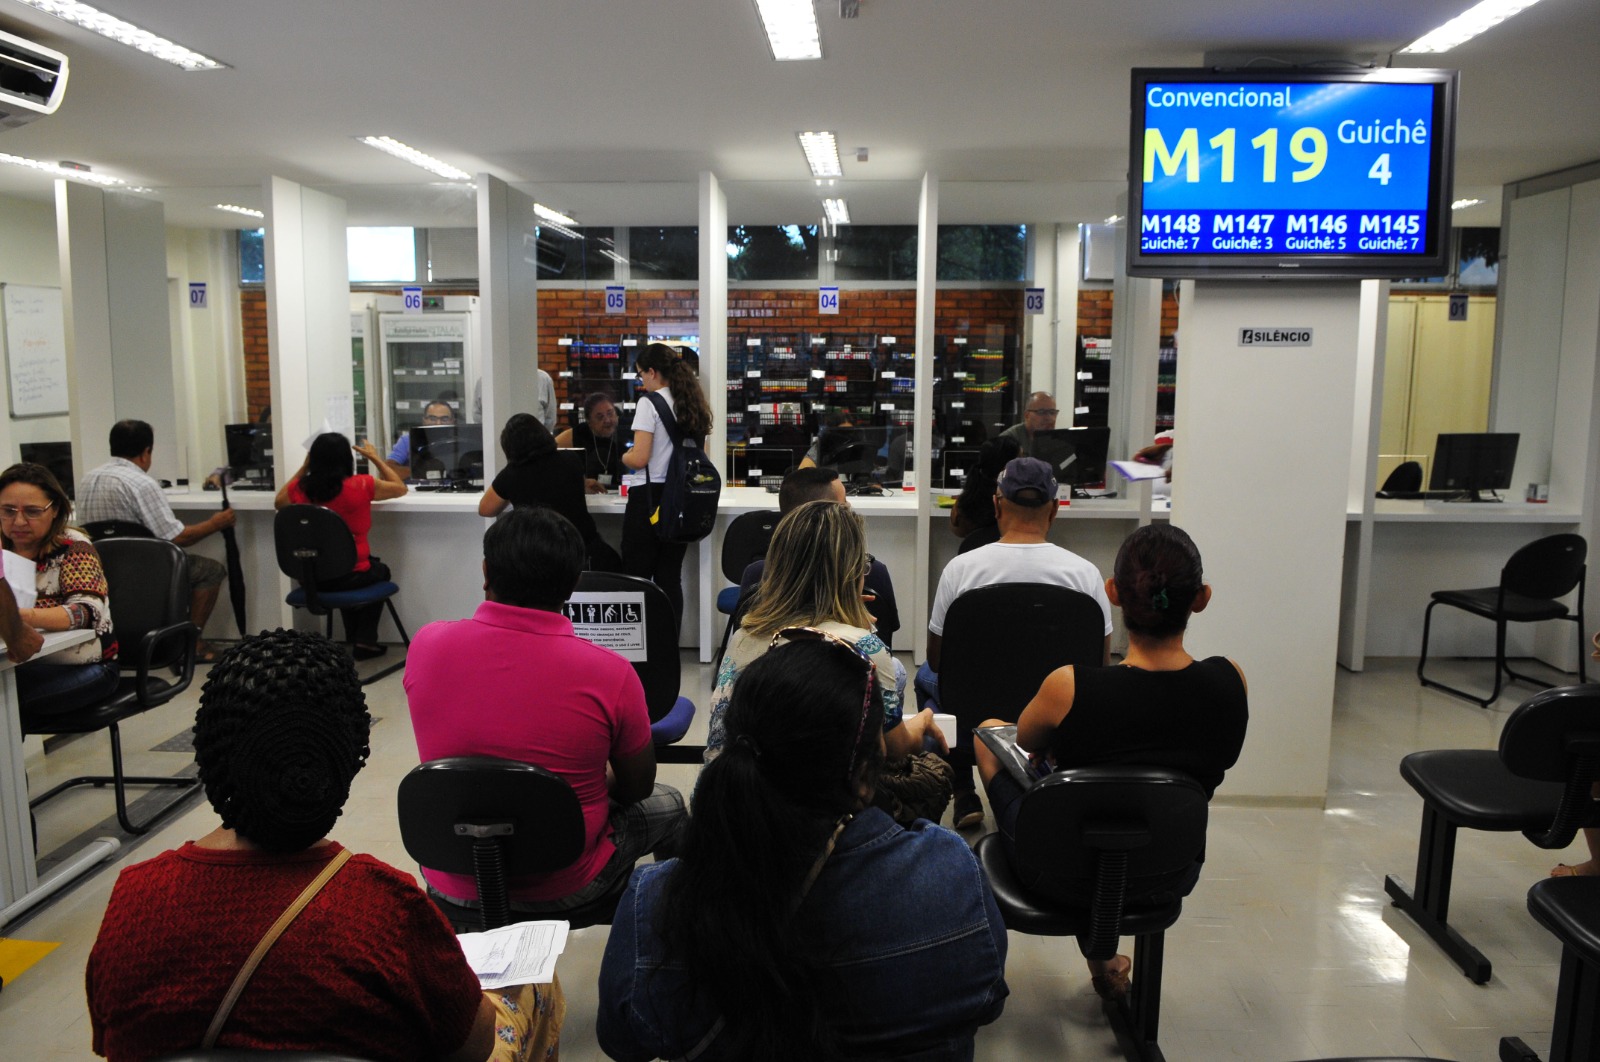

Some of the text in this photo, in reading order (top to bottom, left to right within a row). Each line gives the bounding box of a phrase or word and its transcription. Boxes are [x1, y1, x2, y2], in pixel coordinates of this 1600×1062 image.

[1148, 86, 1292, 108] Convencional
[1337, 118, 1427, 145] Guichê
[1143, 127, 1329, 184] M119
[1367, 153, 1393, 186] 4
[1141, 214, 1420, 235] M148 M147 M146 M145
[1141, 236, 1200, 250] Guichê: 7
[1212, 236, 1273, 250] Guichê: 3
[1285, 236, 1347, 250] Guichê: 5
[1358, 236, 1419, 250] Guichê: 7
[190, 289, 206, 303] 07
[405, 295, 421, 308] 06
[607, 294, 624, 307] 05
[821, 294, 837, 308] 04
[1027, 296, 1043, 310] 03
[1450, 302, 1465, 316] 01
[1254, 329, 1310, 342] SILÊNCIO
